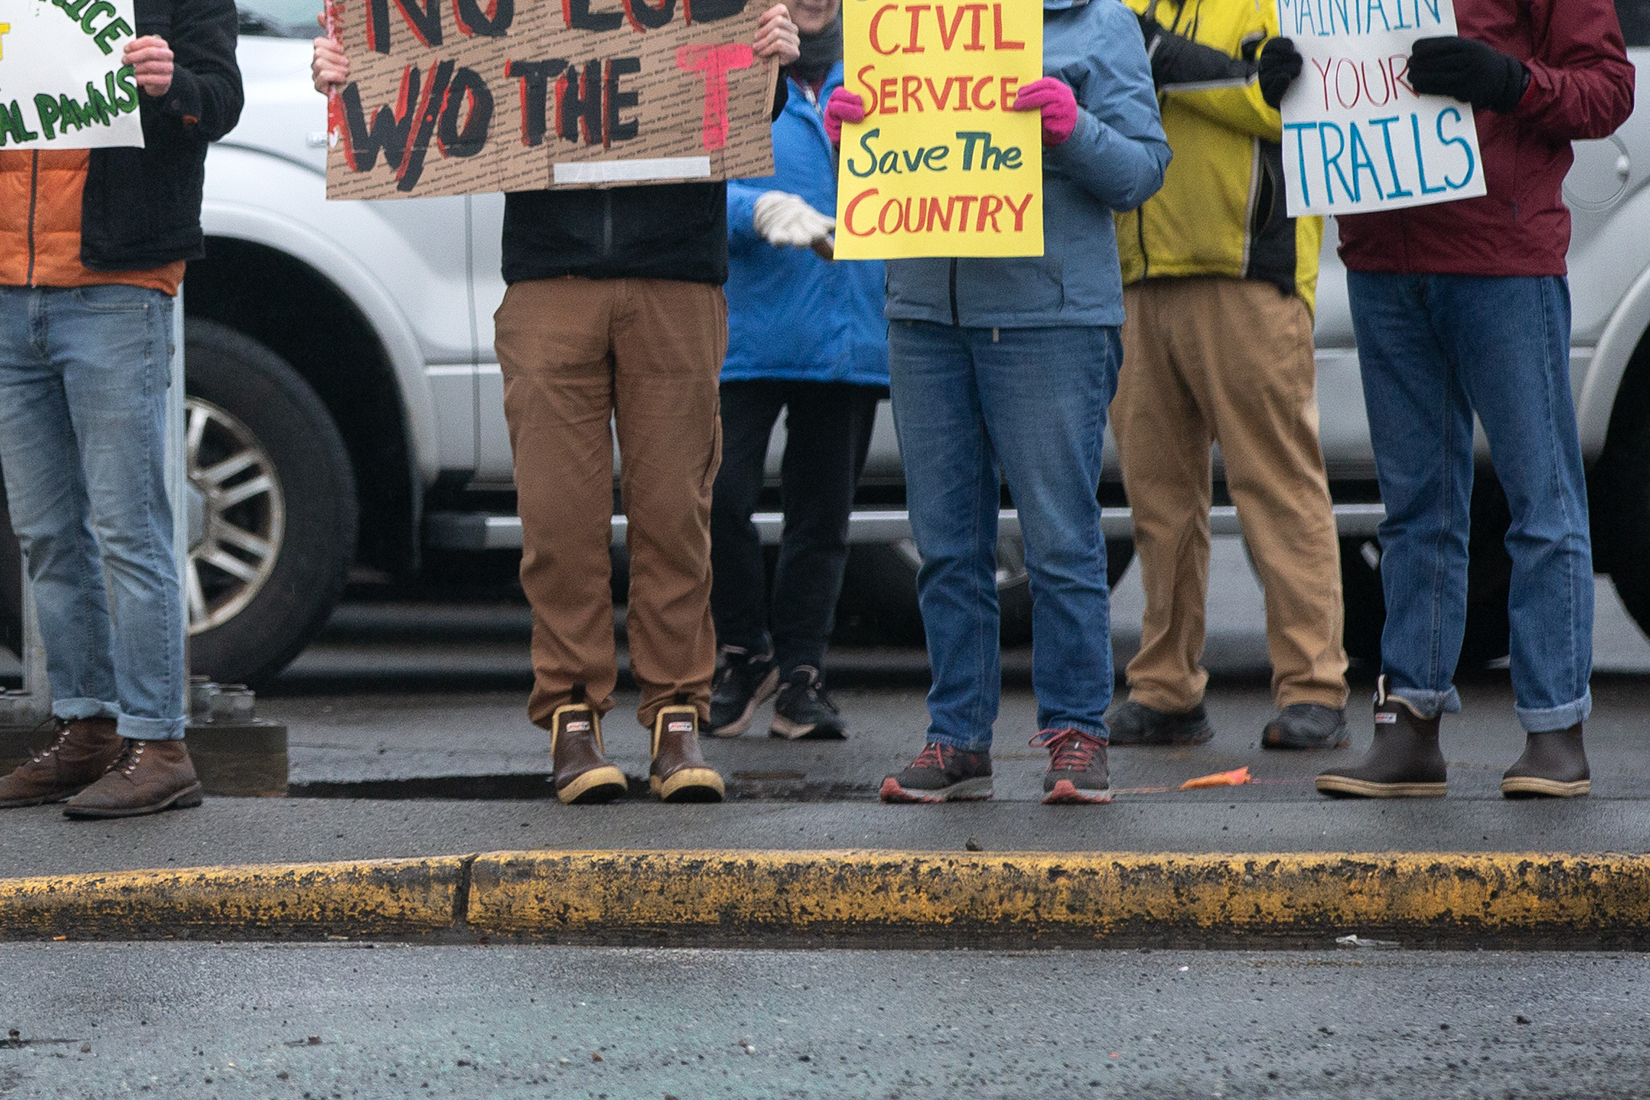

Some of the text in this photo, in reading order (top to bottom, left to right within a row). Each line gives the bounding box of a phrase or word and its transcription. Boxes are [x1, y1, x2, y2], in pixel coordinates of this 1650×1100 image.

[868, 3, 1026, 56] CIVIL
[33, 65, 140, 140] PAWNS
[857, 64, 1020, 117] SERVICE
[1311, 53, 1421, 112] YOUR
[336, 58, 495, 192] W/O
[505, 57, 641, 151] THE
[674, 42, 754, 151] T
[847, 128, 1023, 178] Save The
[1284, 106, 1475, 208] TRAILS
[844, 188, 1034, 238] COUNTRY
